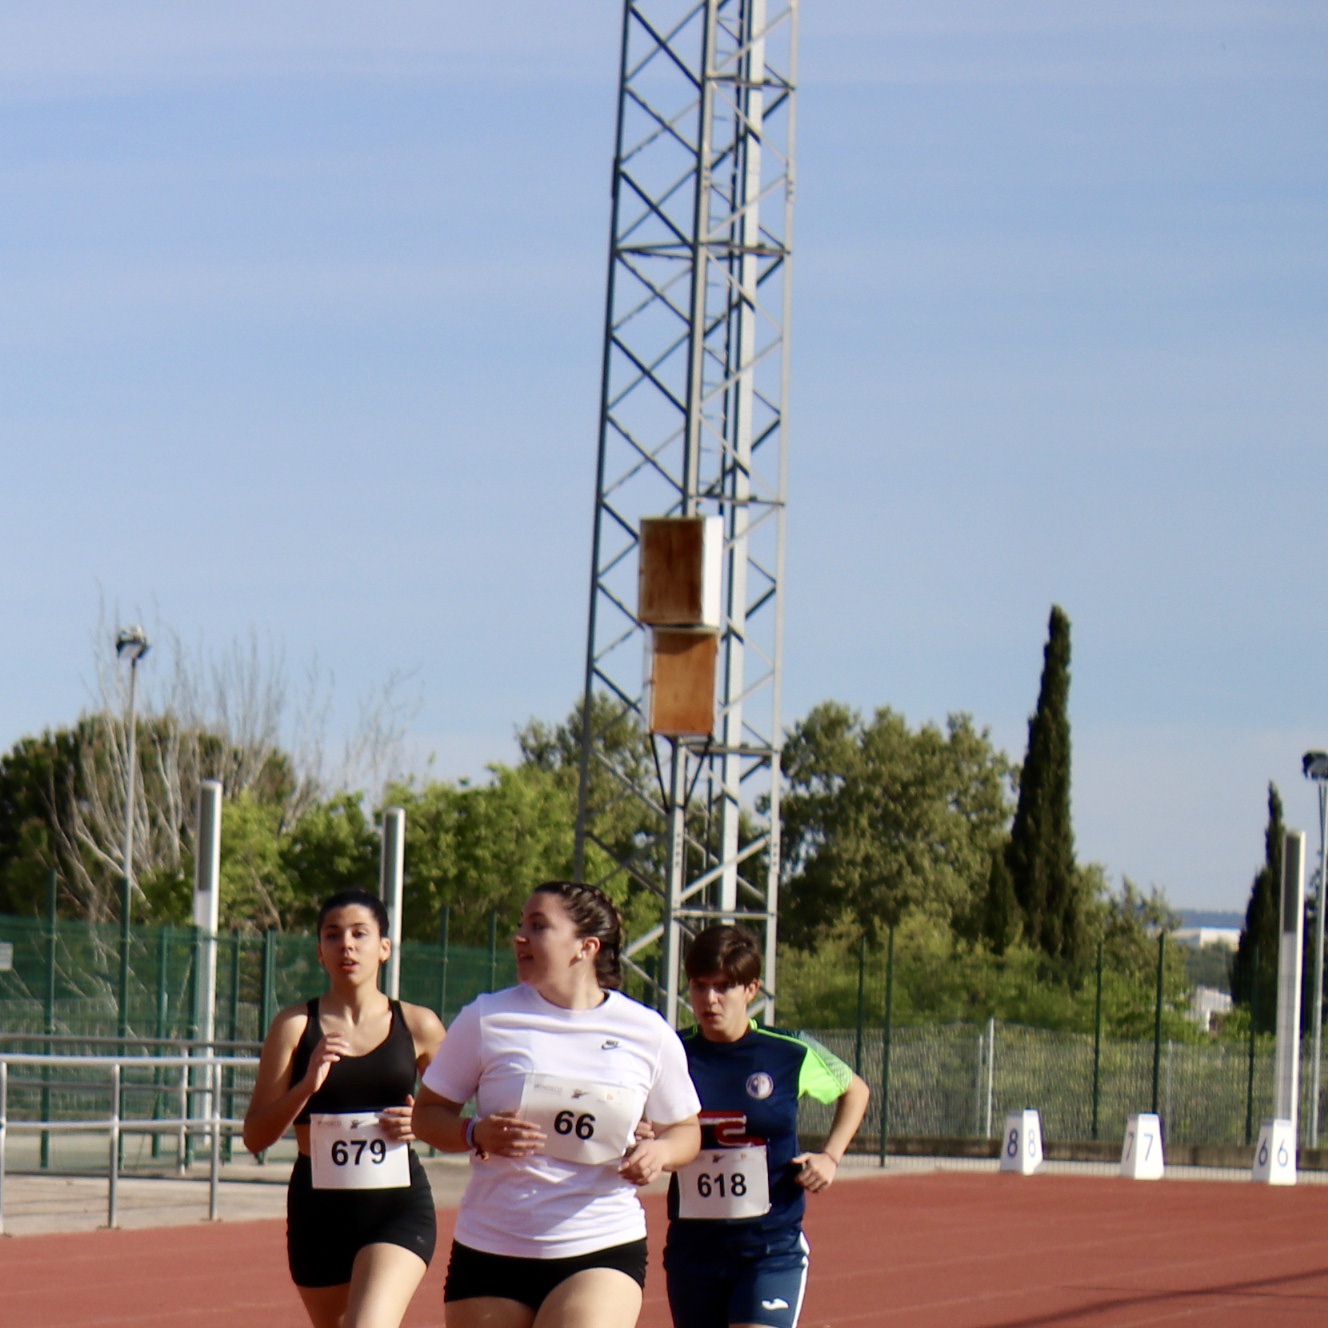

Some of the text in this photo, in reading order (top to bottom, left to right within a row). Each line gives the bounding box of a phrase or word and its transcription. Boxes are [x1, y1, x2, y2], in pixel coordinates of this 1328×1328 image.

[554, 1110, 596, 1140] 66
[331, 1139, 386, 1166] 679
[1007, 1128, 1018, 1158] 8
[1028, 1128, 1036, 1158] 8
[1143, 1133, 1153, 1161] 7
[1258, 1136, 1268, 1168] 6
[1277, 1137, 1289, 1168] 6
[697, 1173, 747, 1198] 618
